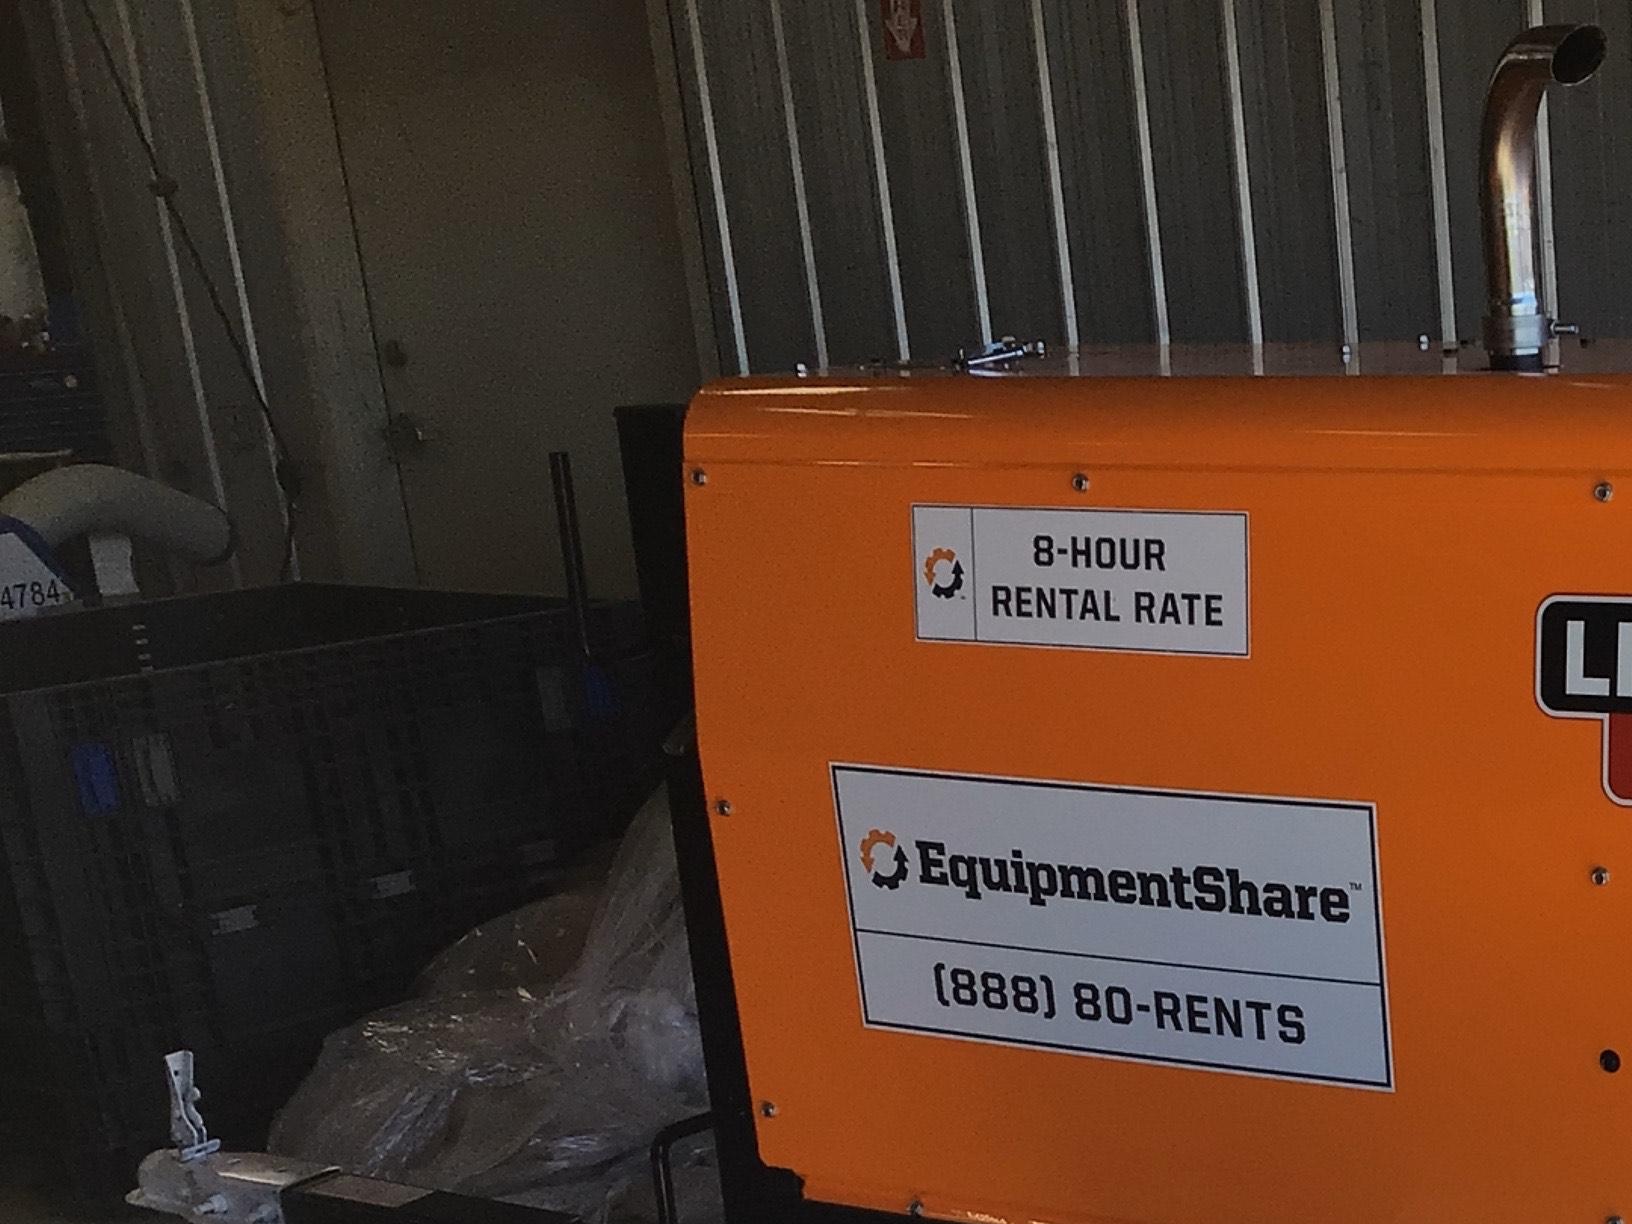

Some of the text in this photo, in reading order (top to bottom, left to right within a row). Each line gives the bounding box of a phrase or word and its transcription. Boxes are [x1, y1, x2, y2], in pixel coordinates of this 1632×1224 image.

[1032, 534, 1167, 573] 8-HOUR
[0, 578, 60, 610] 4784
[991, 584, 1224, 628] RENTAL RATE
[913, 838, 1351, 924] EquipmentShare
[932, 961, 1307, 1046] (888) 80-RENTS
